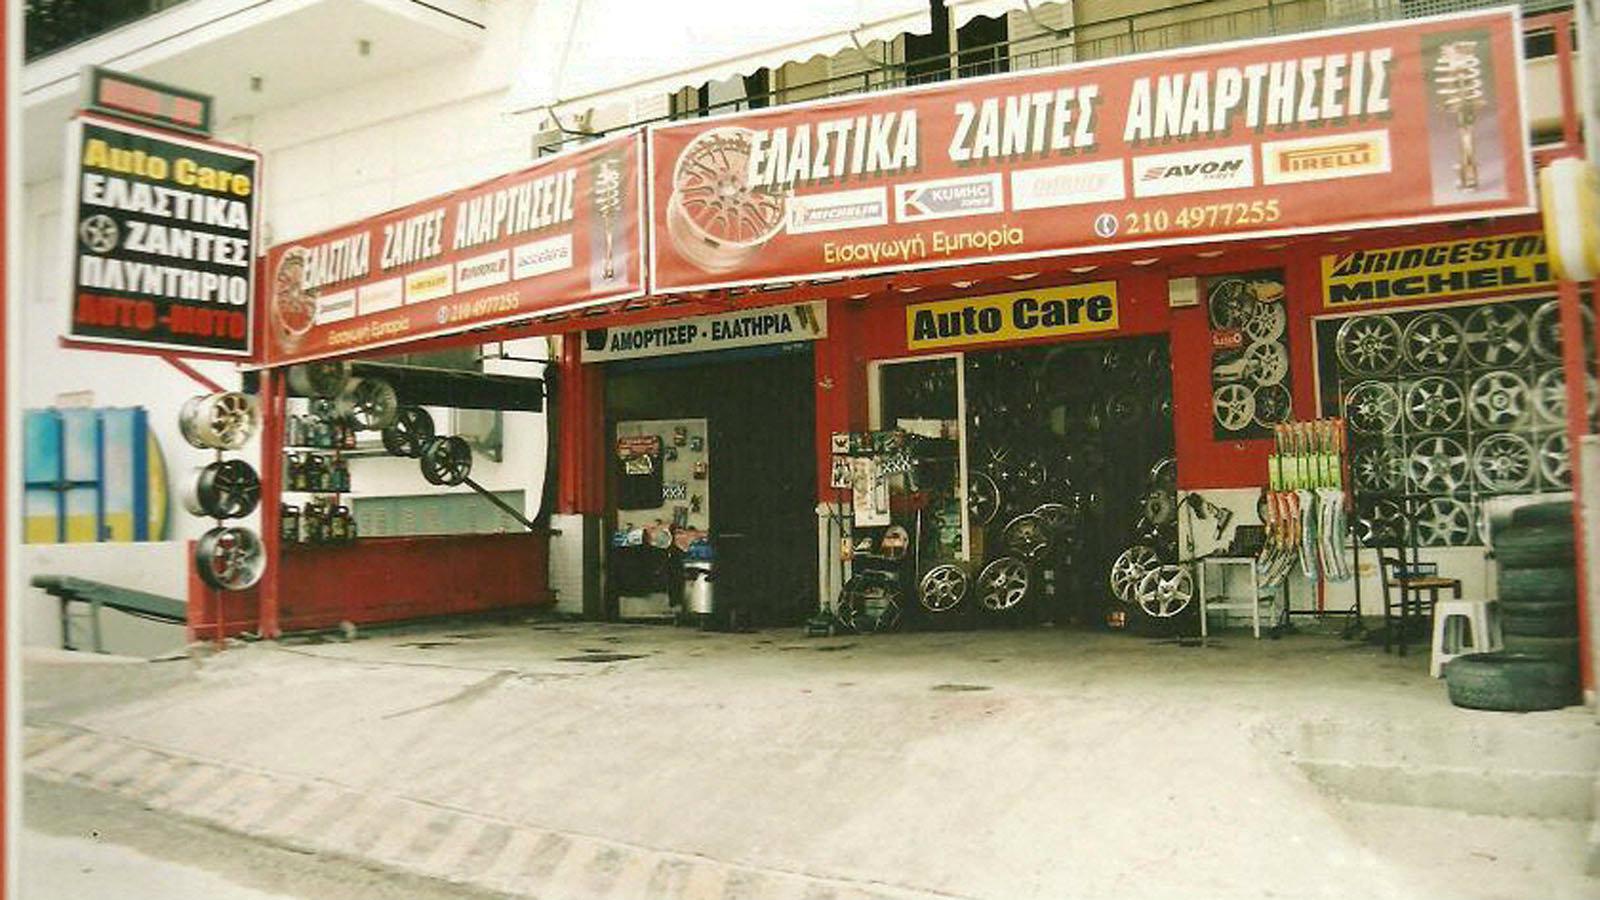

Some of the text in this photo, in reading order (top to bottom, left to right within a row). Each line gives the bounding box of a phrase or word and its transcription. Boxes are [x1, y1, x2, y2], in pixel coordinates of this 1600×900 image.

[746, 48, 1392, 190] ΕΛΑΣΤΙΚΑ ΖΑΝΤΕΣ ΑΝΑΡΤΗΣΕΙΣ
[83, 138, 251, 196] Auto Care
[1163, 157, 1244, 179] AVON
[1280, 142, 1372, 172] PIRELLI
[82, 173, 249, 230] ΕΛΑΣΤΙΚΑ
[931, 186, 991, 203] KUMHO
[1125, 199, 1281, 234] 210 4977255
[124, 220, 249, 266] ΖΑΝΤΕΣ
[823, 225, 1024, 264] Εισαγωγή Εμπορία
[79, 254, 247, 305] ΠΛΥΝΤΗΡΙΟ
[611, 324, 697, 352] ΑΜΟΡΤΙΣΕΡ
[711, 313, 792, 341] ΕΛΑΤΗΡΙΑ
[913, 293, 1114, 342] Auto Care
